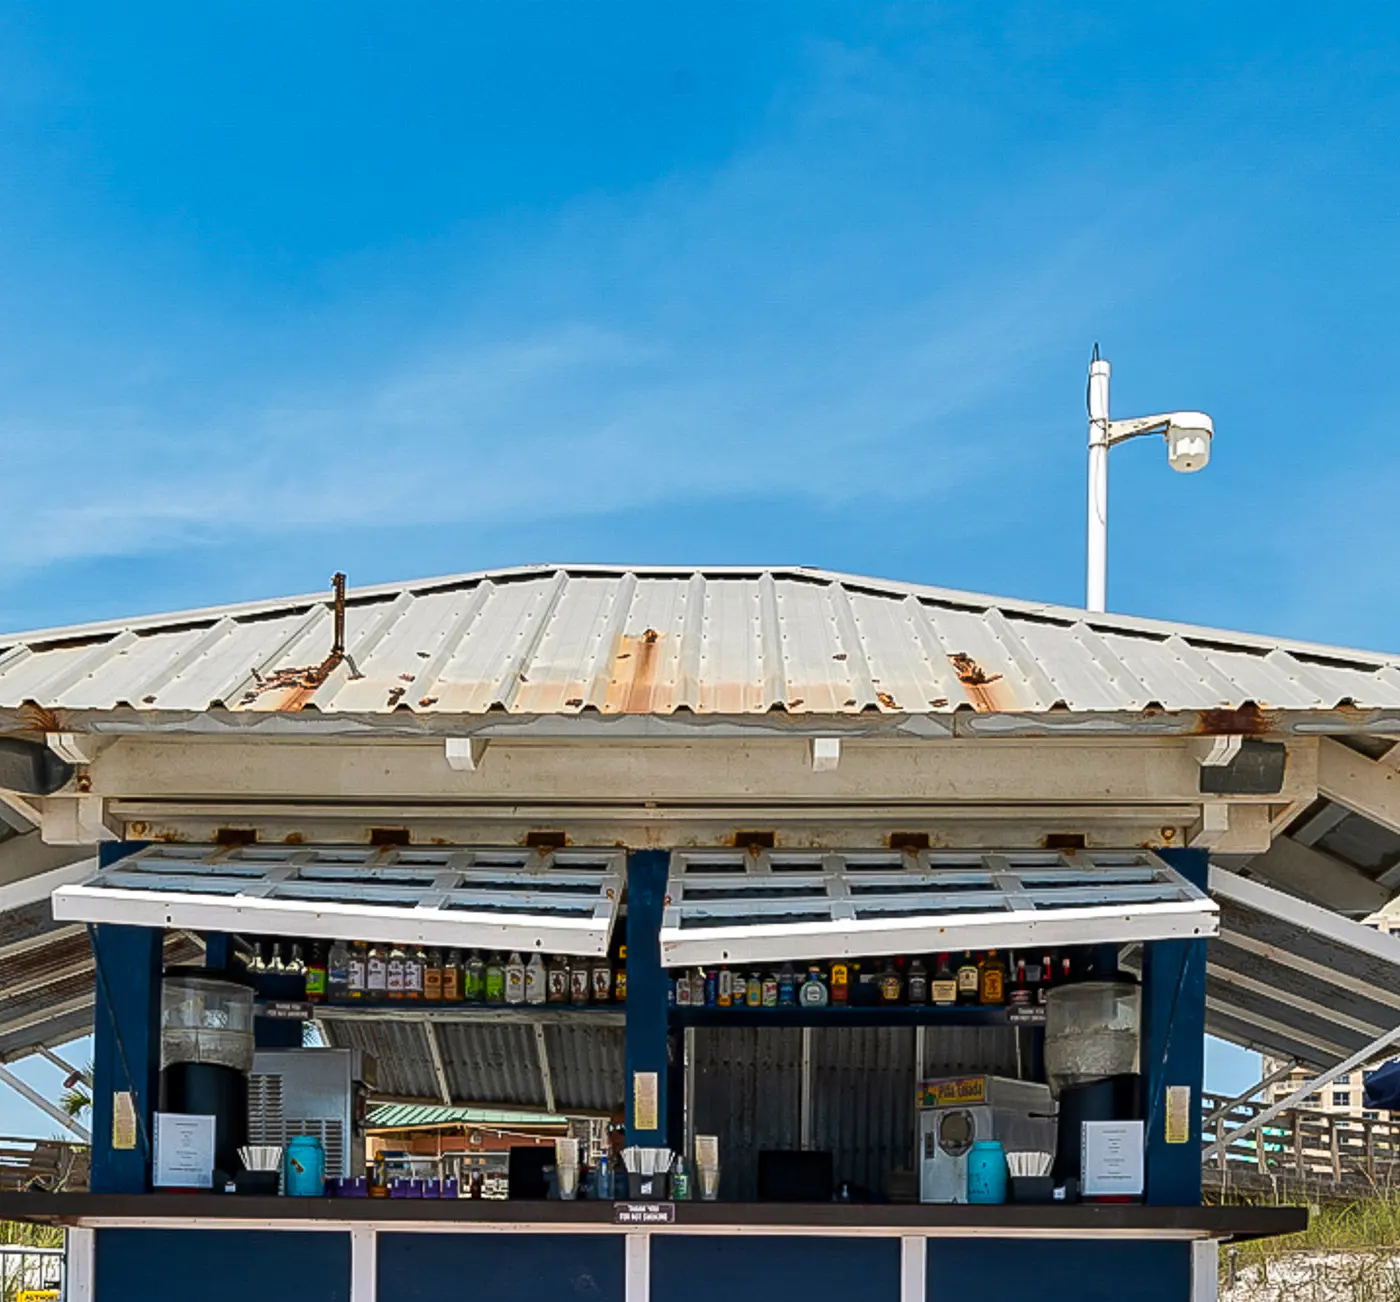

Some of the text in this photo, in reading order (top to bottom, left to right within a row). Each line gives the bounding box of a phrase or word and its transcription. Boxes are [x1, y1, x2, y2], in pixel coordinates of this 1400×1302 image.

[627, 1204, 660, 1212] THANK YOU
[619, 1212, 668, 1222] FOR NOT SMOKING
